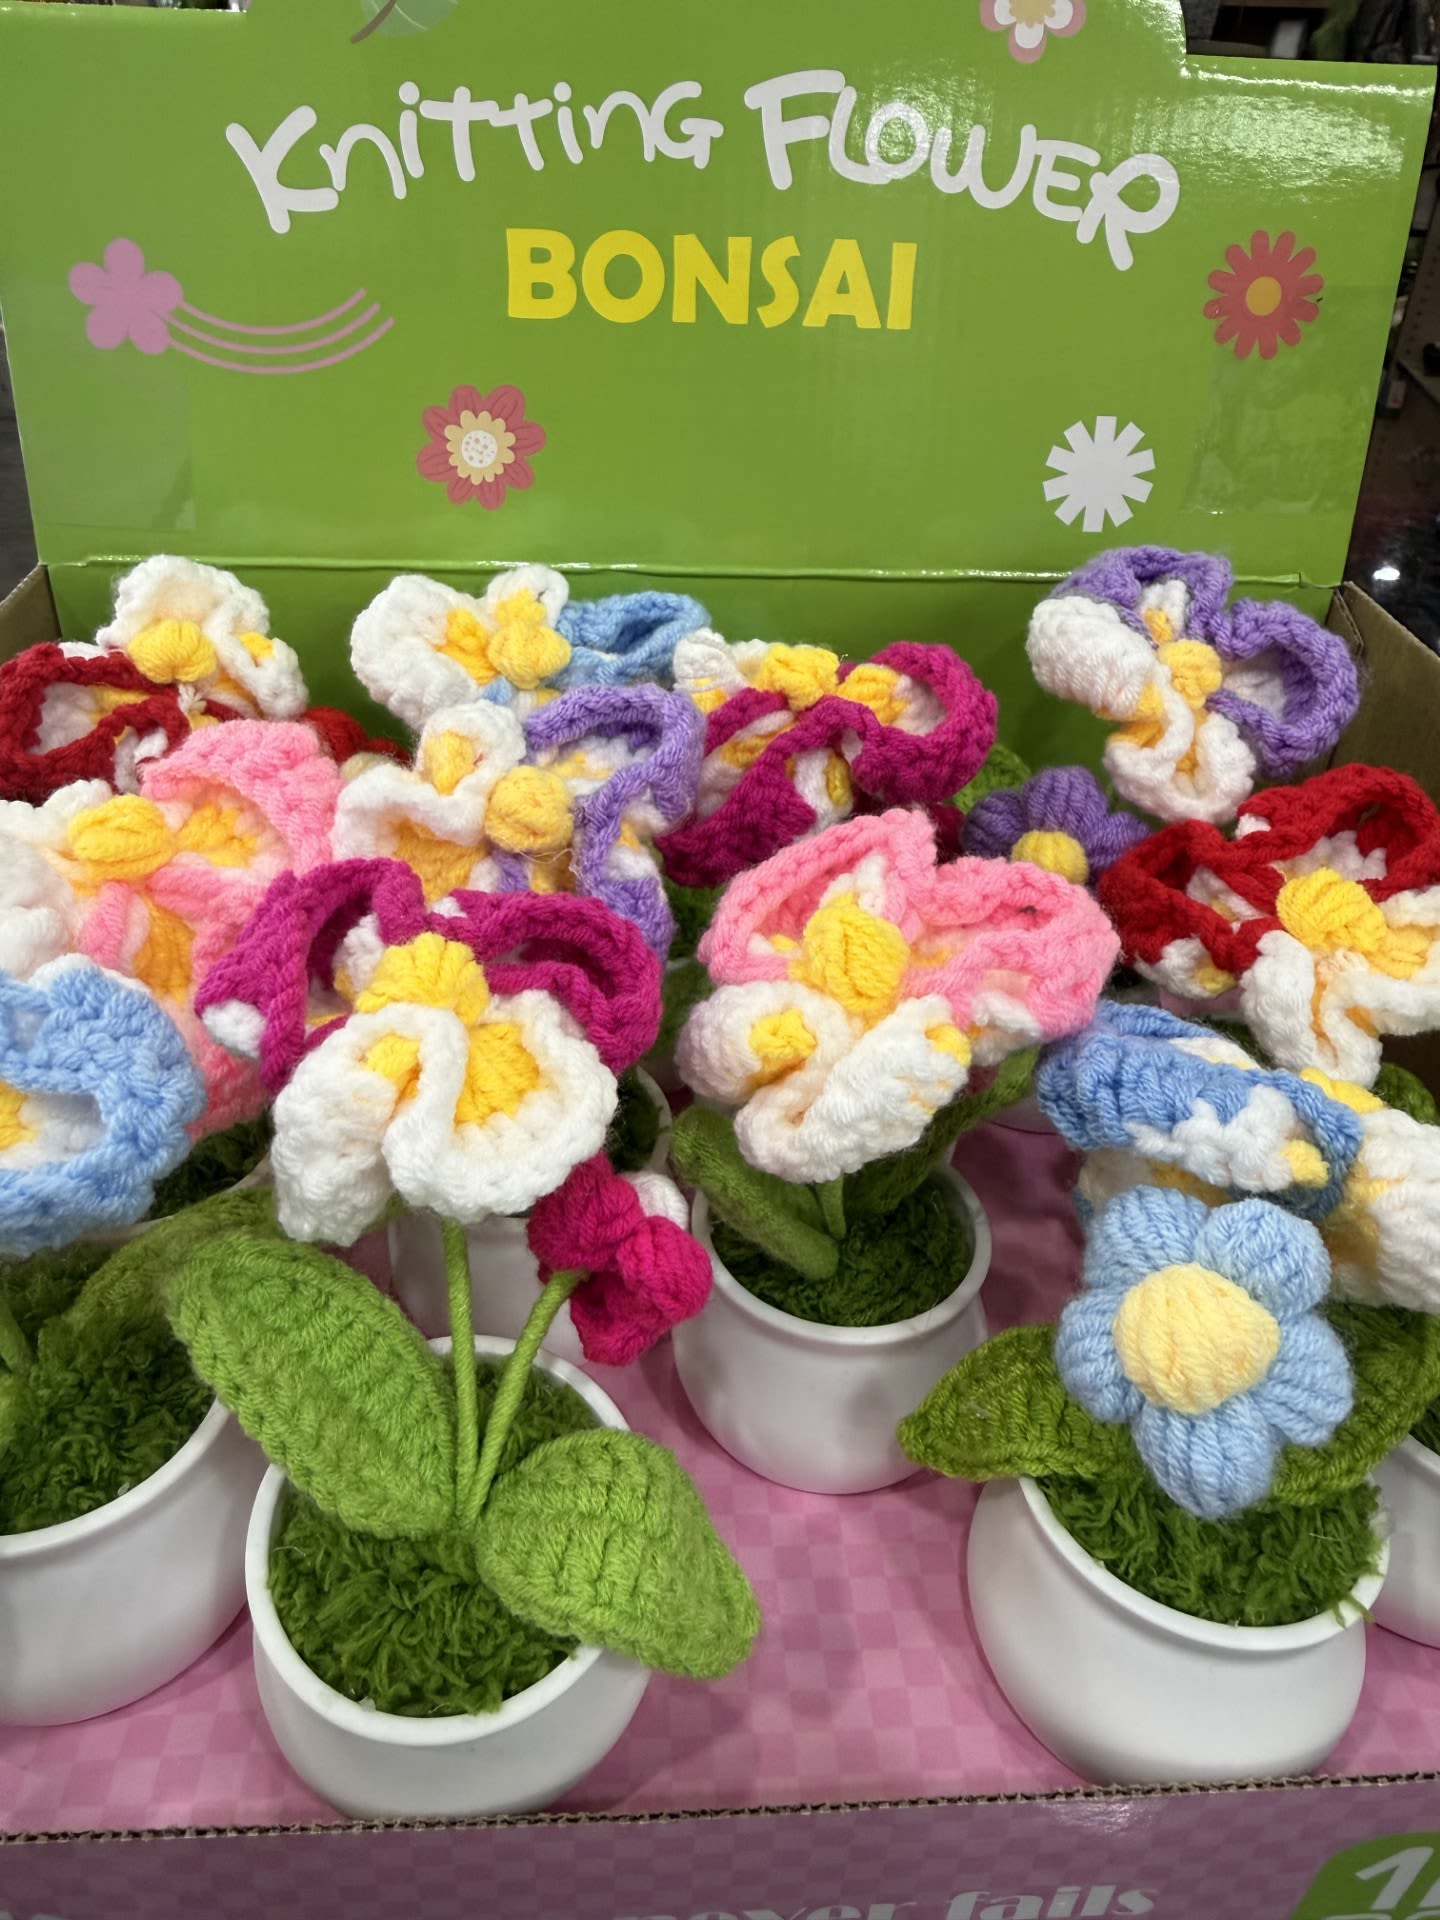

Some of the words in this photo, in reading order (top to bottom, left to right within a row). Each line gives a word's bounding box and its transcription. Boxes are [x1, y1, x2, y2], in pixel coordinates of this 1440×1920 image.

[506, 228, 917, 329] BONSAI
[947, 1884, 1160, 1920] fails
[1354, 1846, 1440, 1910] 1
